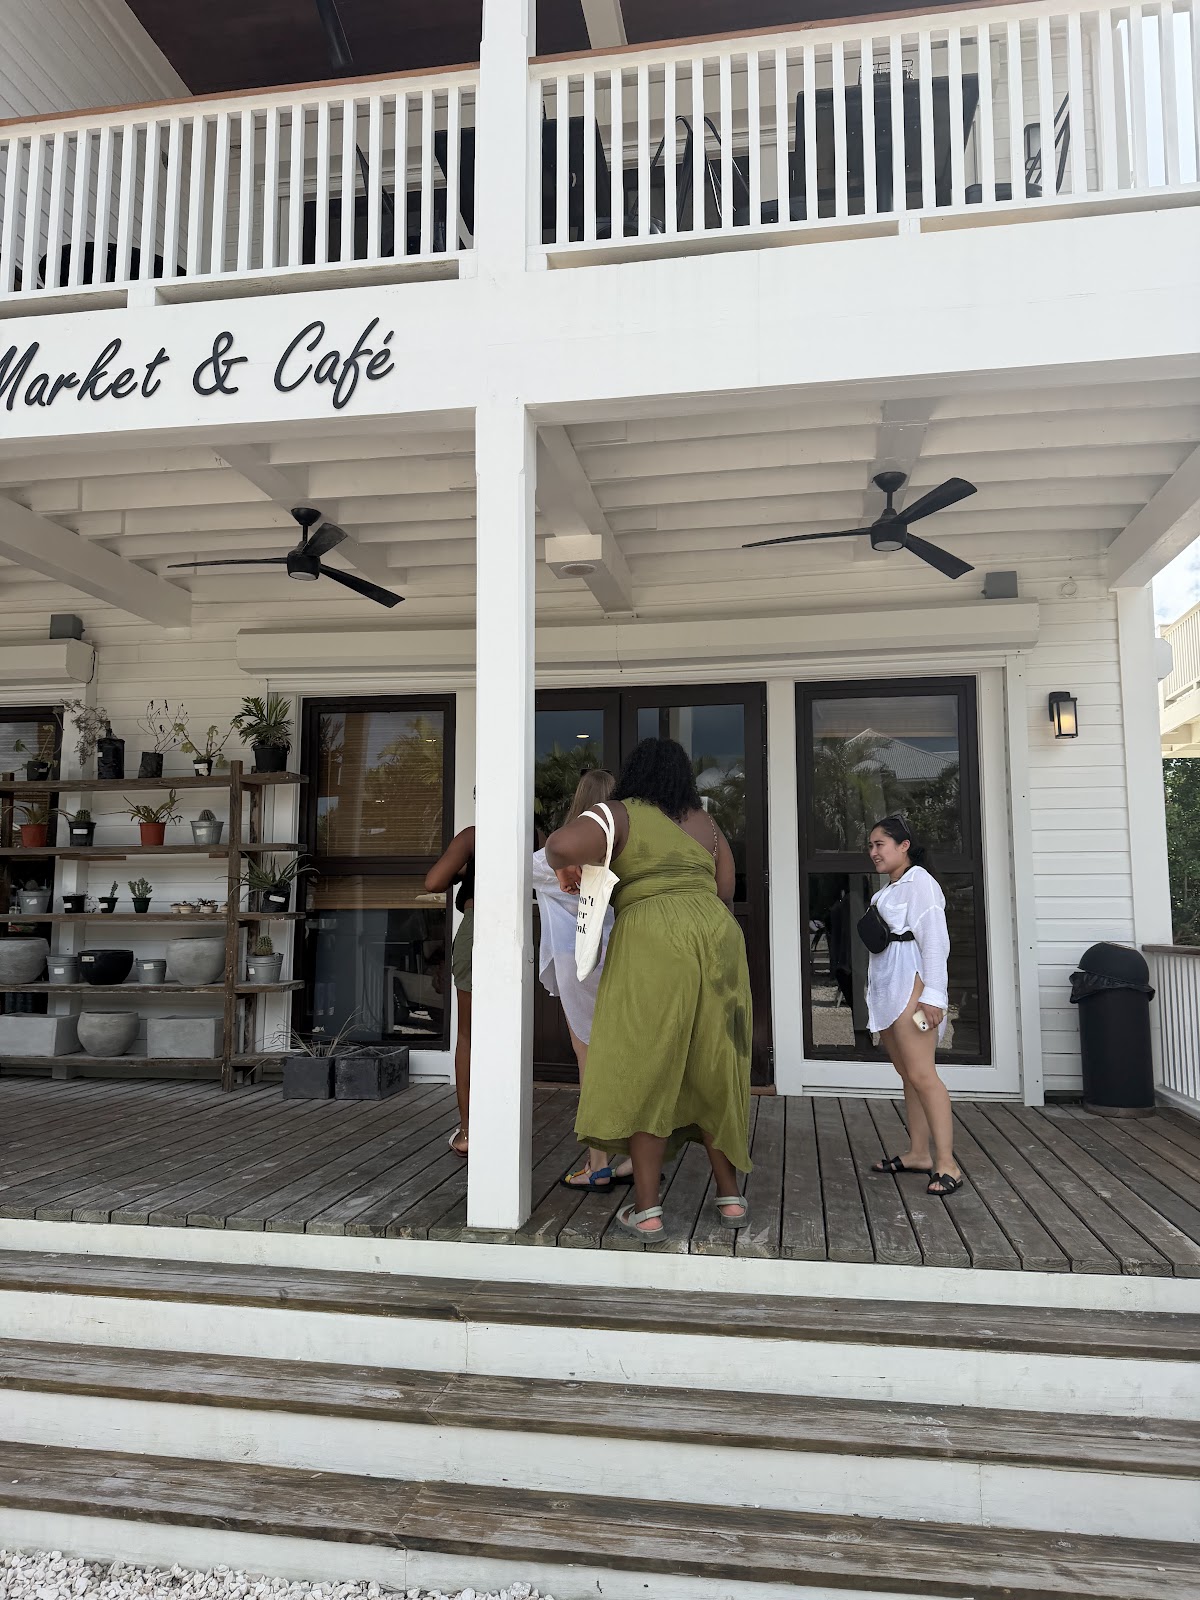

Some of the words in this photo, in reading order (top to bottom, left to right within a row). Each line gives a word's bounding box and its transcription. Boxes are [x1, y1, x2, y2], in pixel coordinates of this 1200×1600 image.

[0, 337, 170, 411] Market
[192, 331, 248, 396] &
[273, 317, 395, 409] Café
[579, 895, 594, 907] on't
[576, 921, 588, 935] ink
